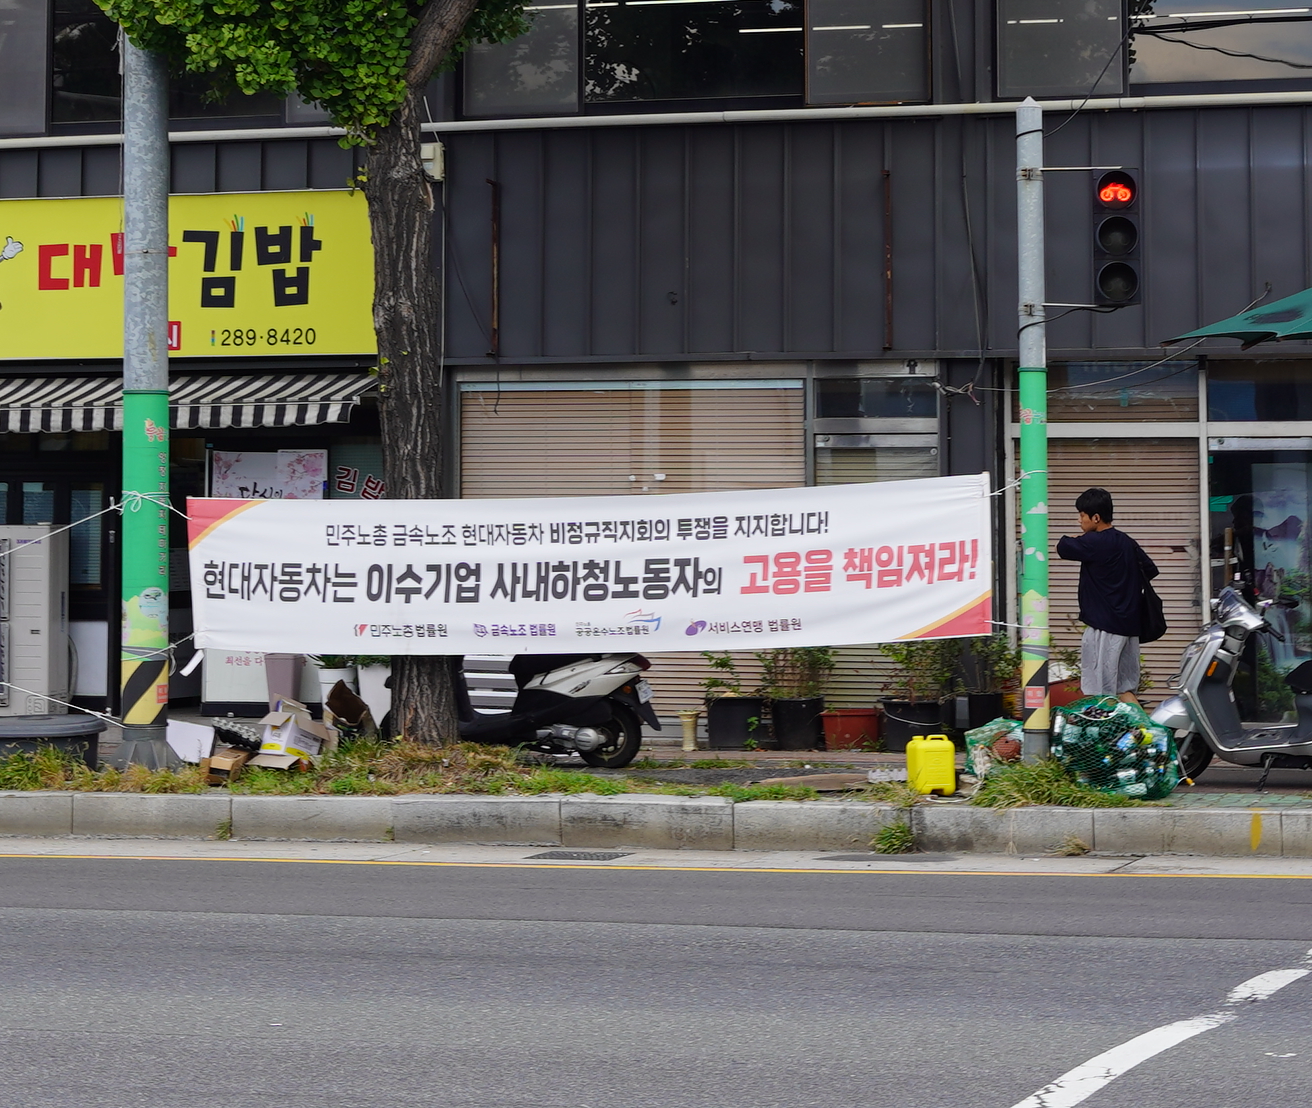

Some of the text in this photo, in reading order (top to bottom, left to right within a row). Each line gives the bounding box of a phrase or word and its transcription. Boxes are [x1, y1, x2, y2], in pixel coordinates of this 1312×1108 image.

[37, 225, 323, 309] 대김밥
[325, 510, 830, 547] 민주노총 금속노조 현대자동차 비정규직지회의 투쟁을 지지합니다!
[202, 538, 979, 604] 현대자동차는 이수기업 사내하청노동자의 고용을 책임져라!
[491, 623, 557, 637] 금속노조 법률원
[708, 618, 802, 635] 서비스연맹 법률원
